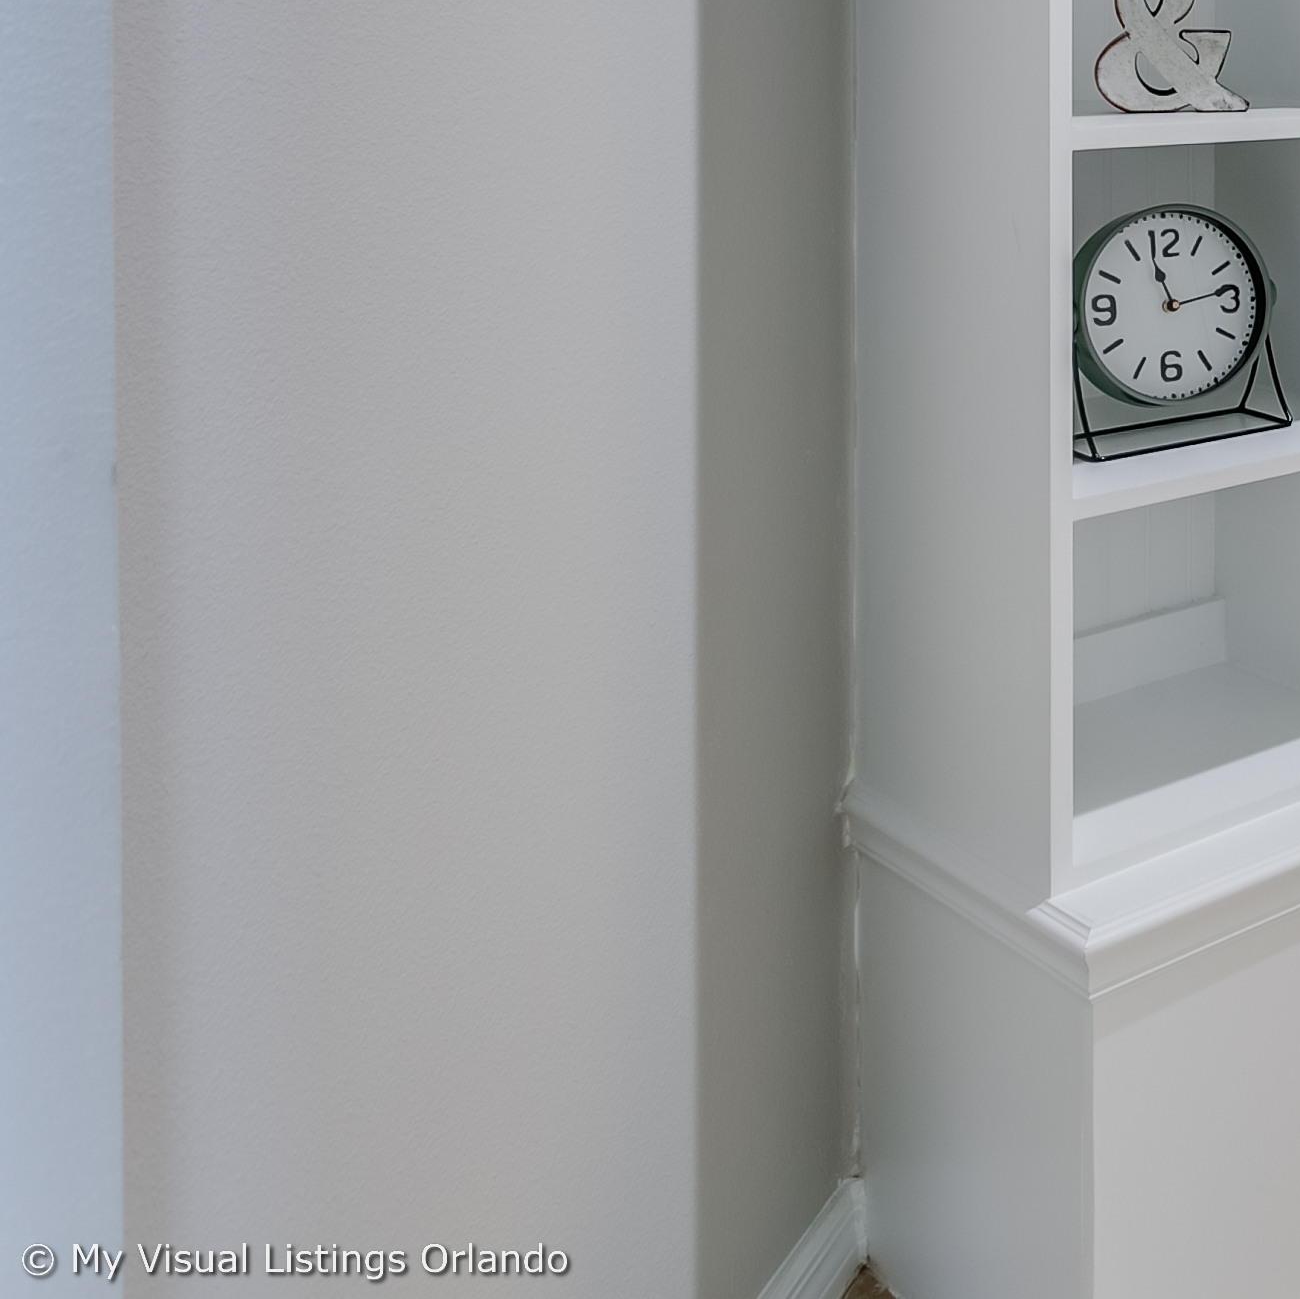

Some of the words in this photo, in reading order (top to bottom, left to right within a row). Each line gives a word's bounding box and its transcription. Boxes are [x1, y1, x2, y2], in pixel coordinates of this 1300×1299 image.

[1147, 228, 1180, 258] 12
[1091, 294, 1117, 326] 9
[1217, 284, 1240, 313] 3
[1160, 350, 1183, 382] 6
